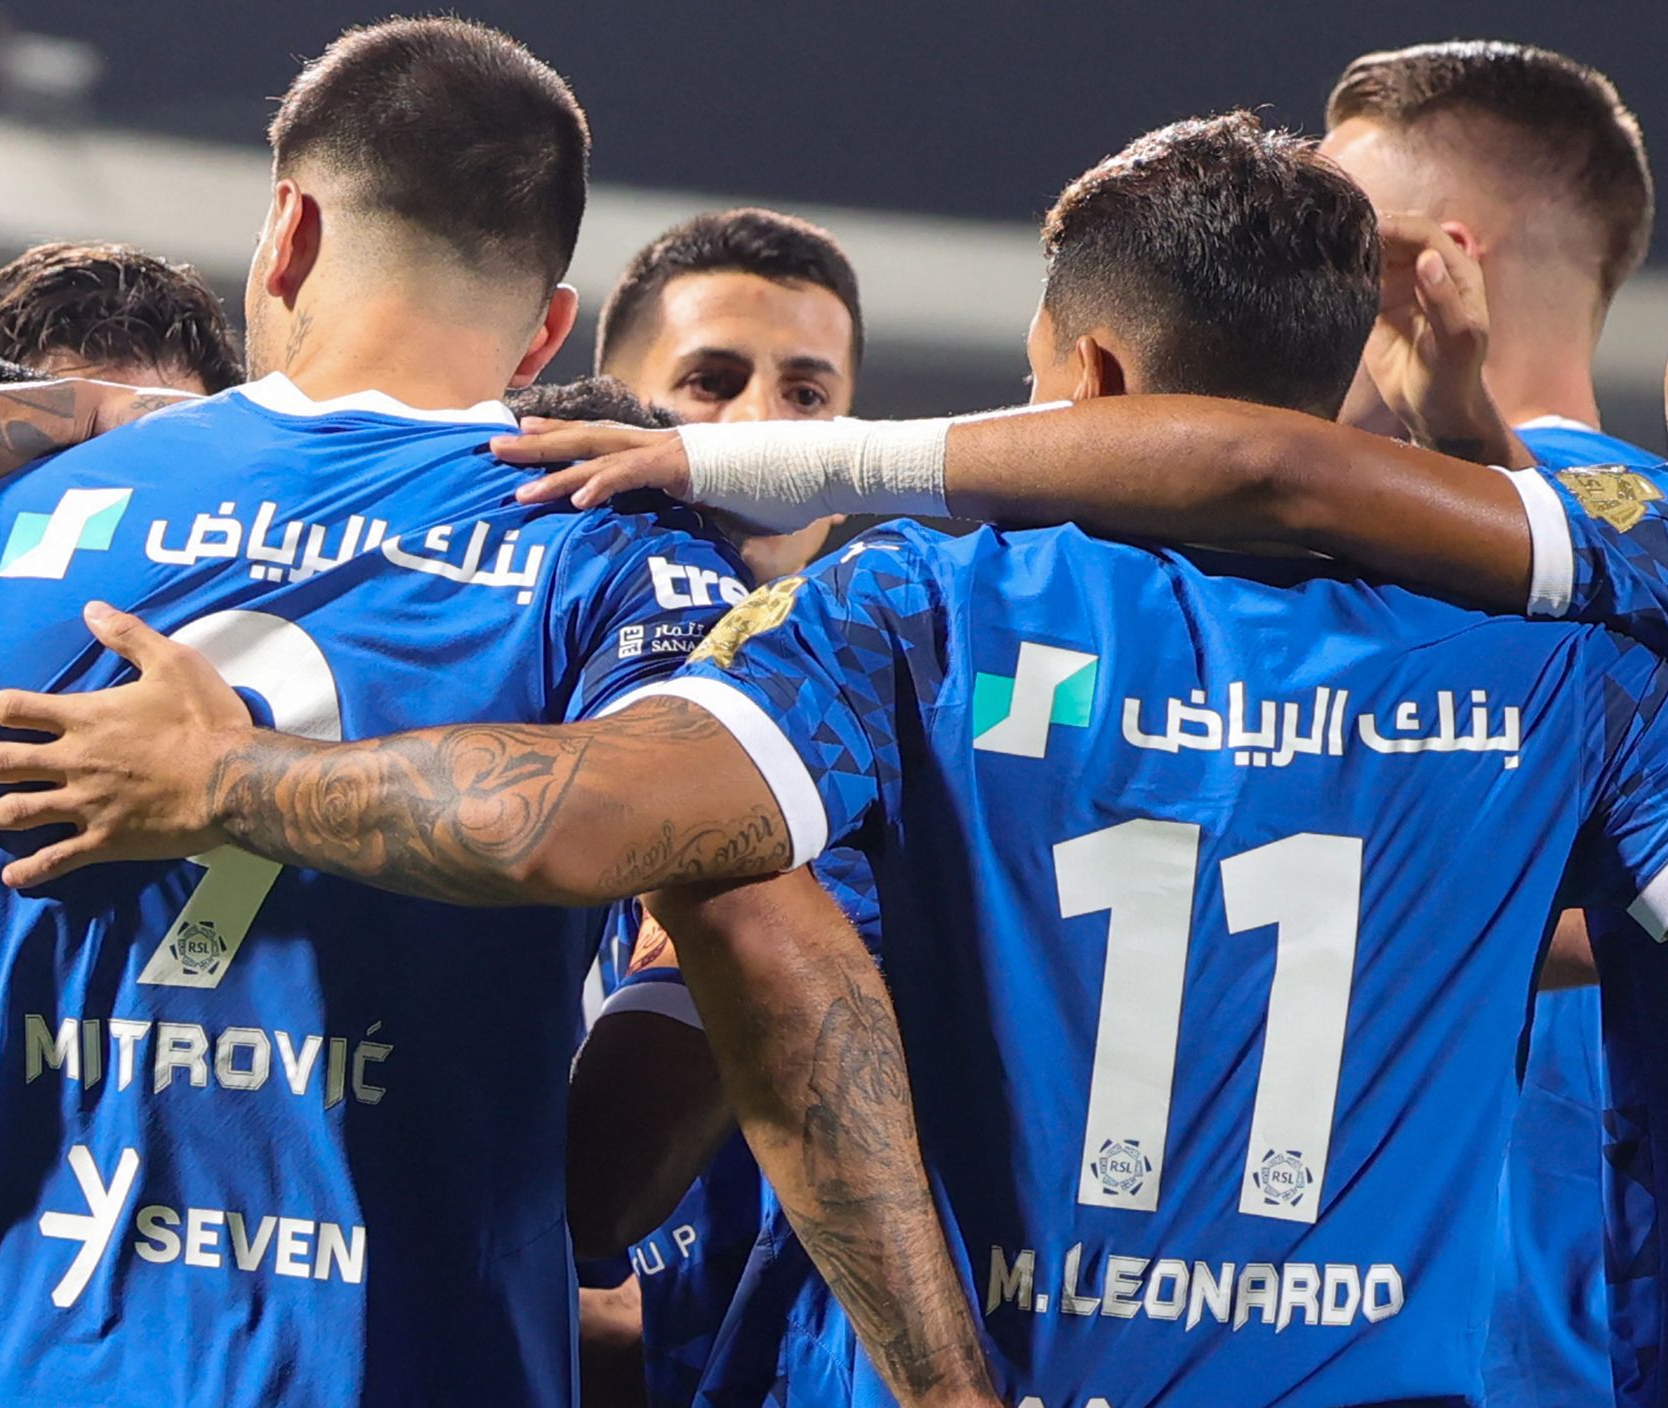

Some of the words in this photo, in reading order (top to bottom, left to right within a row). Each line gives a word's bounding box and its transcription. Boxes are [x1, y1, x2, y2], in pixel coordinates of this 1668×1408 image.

[145, 501, 387, 583] الرياض
[381, 520, 545, 605] بنك
[648, 556, 750, 610] tre
[652, 639, 697, 652] SANA
[1122, 681, 1348, 767] الرياض
[1358, 690, 1520, 769] بنك
[188, 941, 210, 953] RSL
[1053, 818, 1363, 1223] 11
[24, 1013, 393, 1108] MITROVIĆ
[1110, 1160, 1132, 1174] RSL
[1272, 1171, 1294, 1185] RSL
[135, 1205, 366, 1283] SEVEN
[986, 1245, 1048, 1316] M.
[1061, 1242, 1405, 1333] LEONARDO
